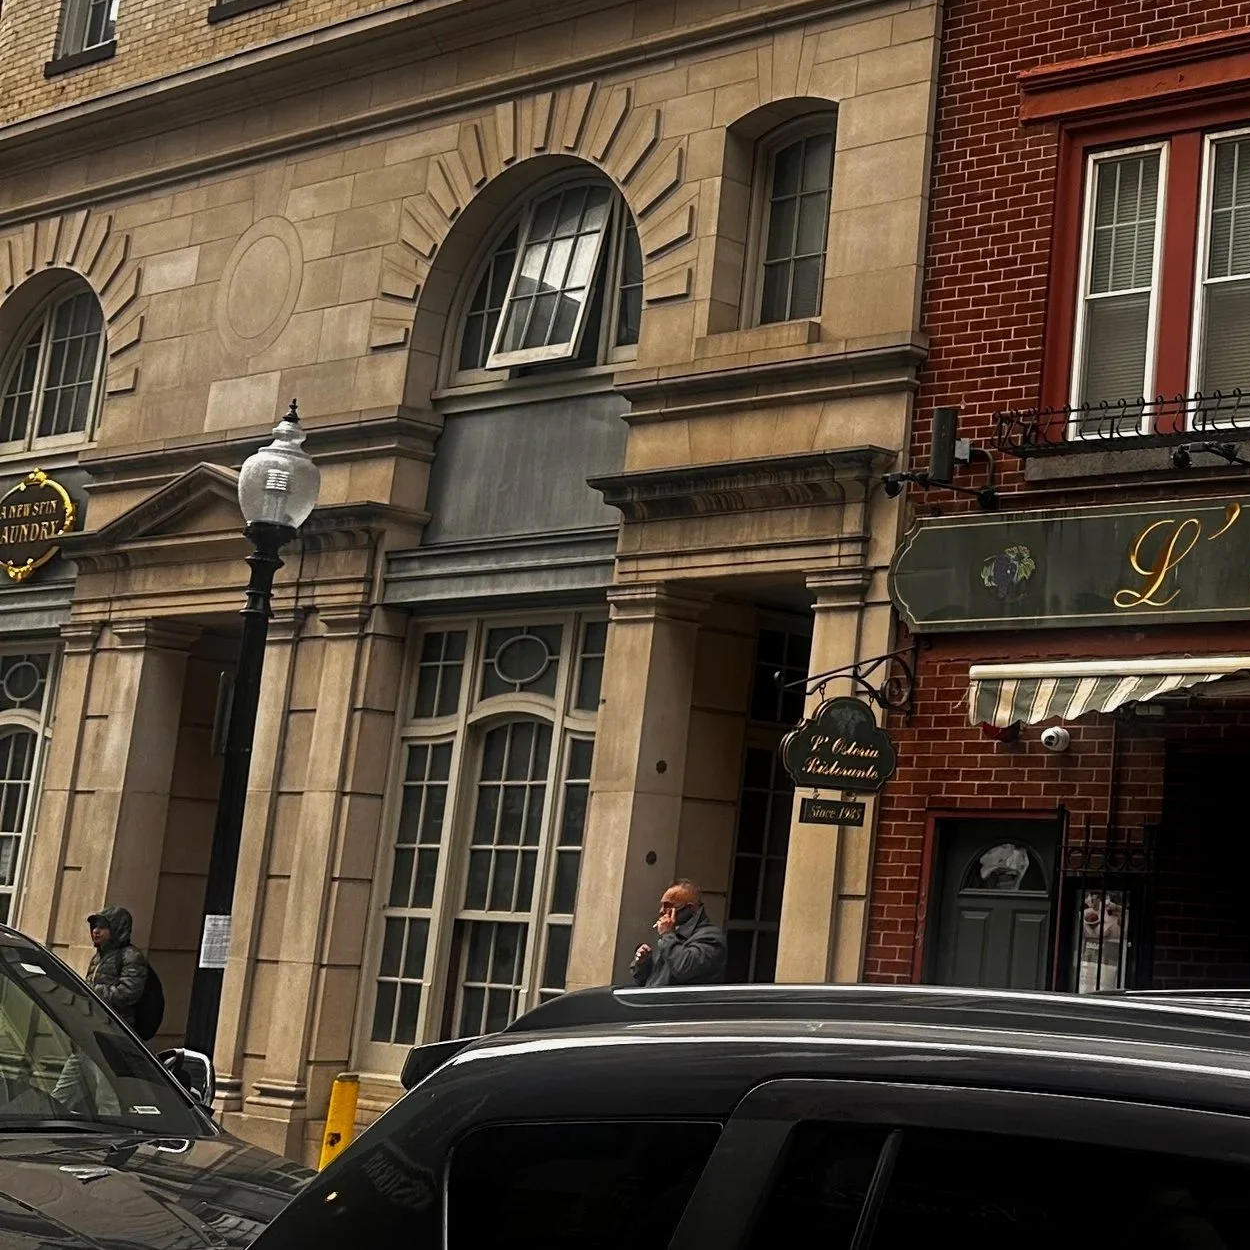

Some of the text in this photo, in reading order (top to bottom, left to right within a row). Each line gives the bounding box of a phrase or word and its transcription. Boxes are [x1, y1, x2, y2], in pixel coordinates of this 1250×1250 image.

[9, 503, 31, 518] NEW
[32, 500, 57, 516] SPIN
[0, 520, 59, 544] AUNDRY
[802, 757, 879, 780] Ristorante
[812, 806, 860, 820] Since 1985
